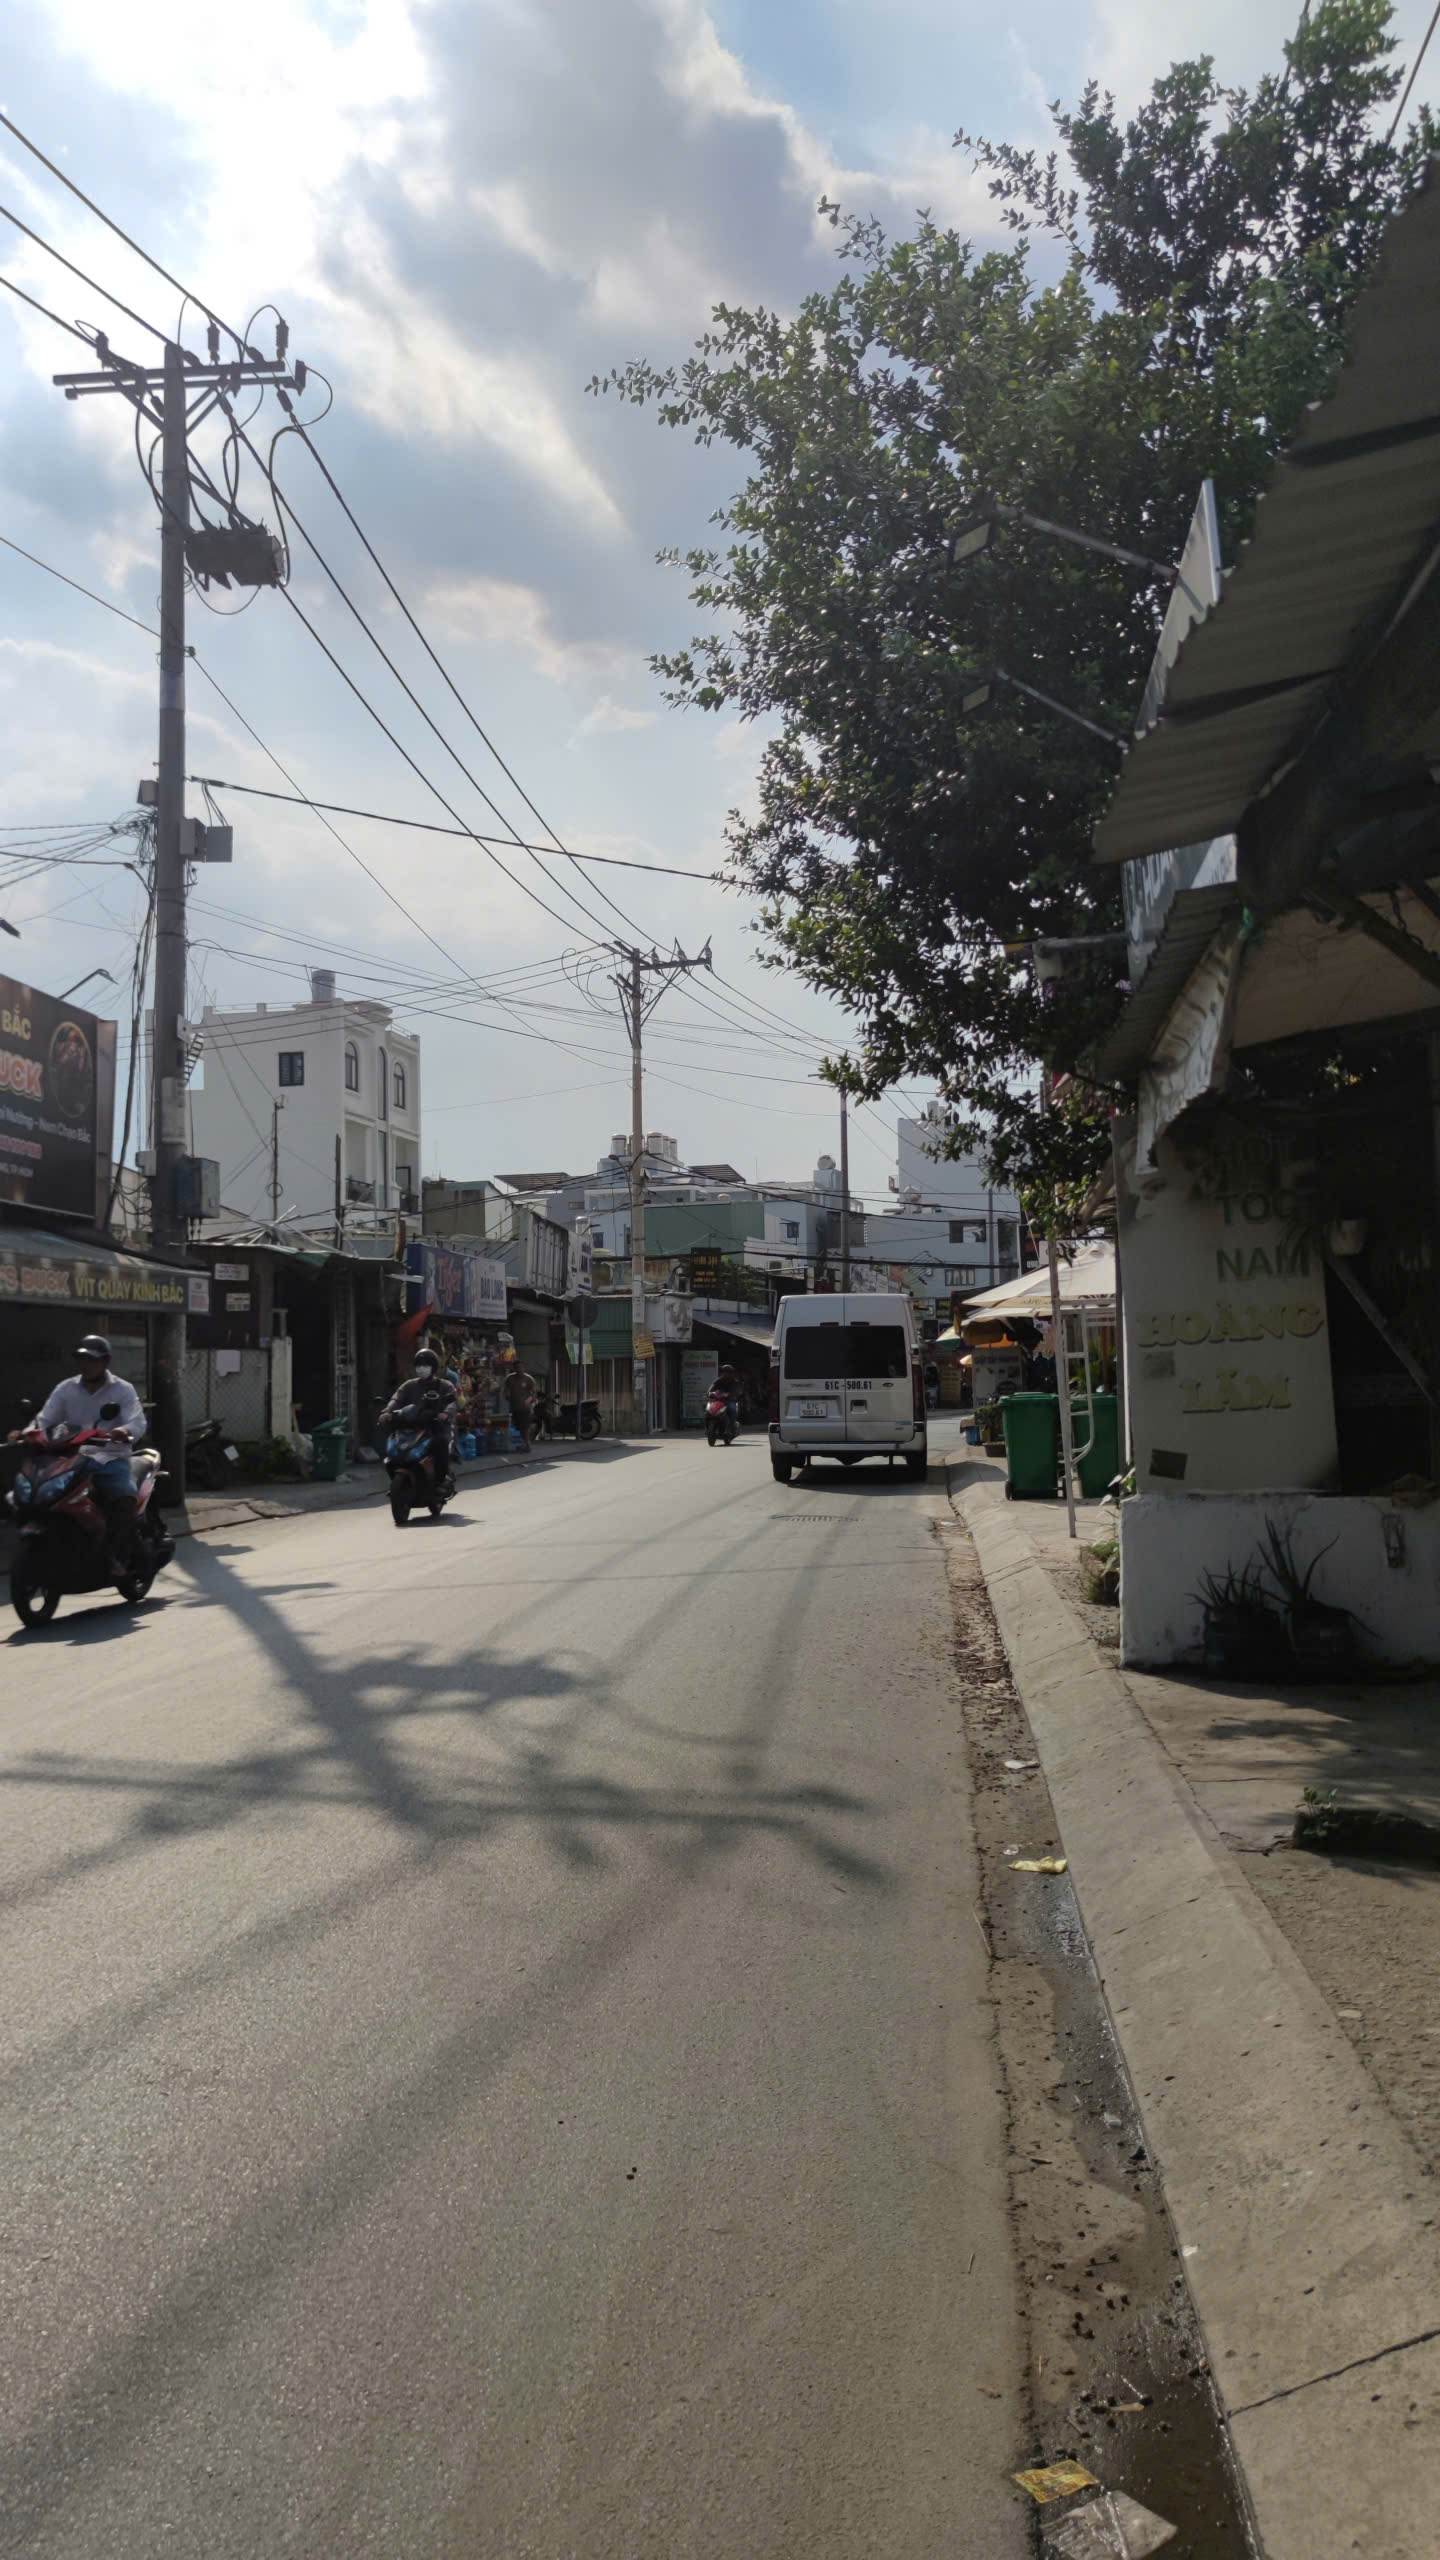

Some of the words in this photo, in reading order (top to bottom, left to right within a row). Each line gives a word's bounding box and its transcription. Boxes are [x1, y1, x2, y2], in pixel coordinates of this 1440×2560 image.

[2, 1003, 32, 1041] BẮC
[1216, 1247, 1310, 1283] NAM
[21, 1266, 71, 1297] DUCK
[161, 1276, 184, 1304] BẮC
[825, 1380, 840, 1390] 61C
[846, 1380, 872, 1390] 500.61
